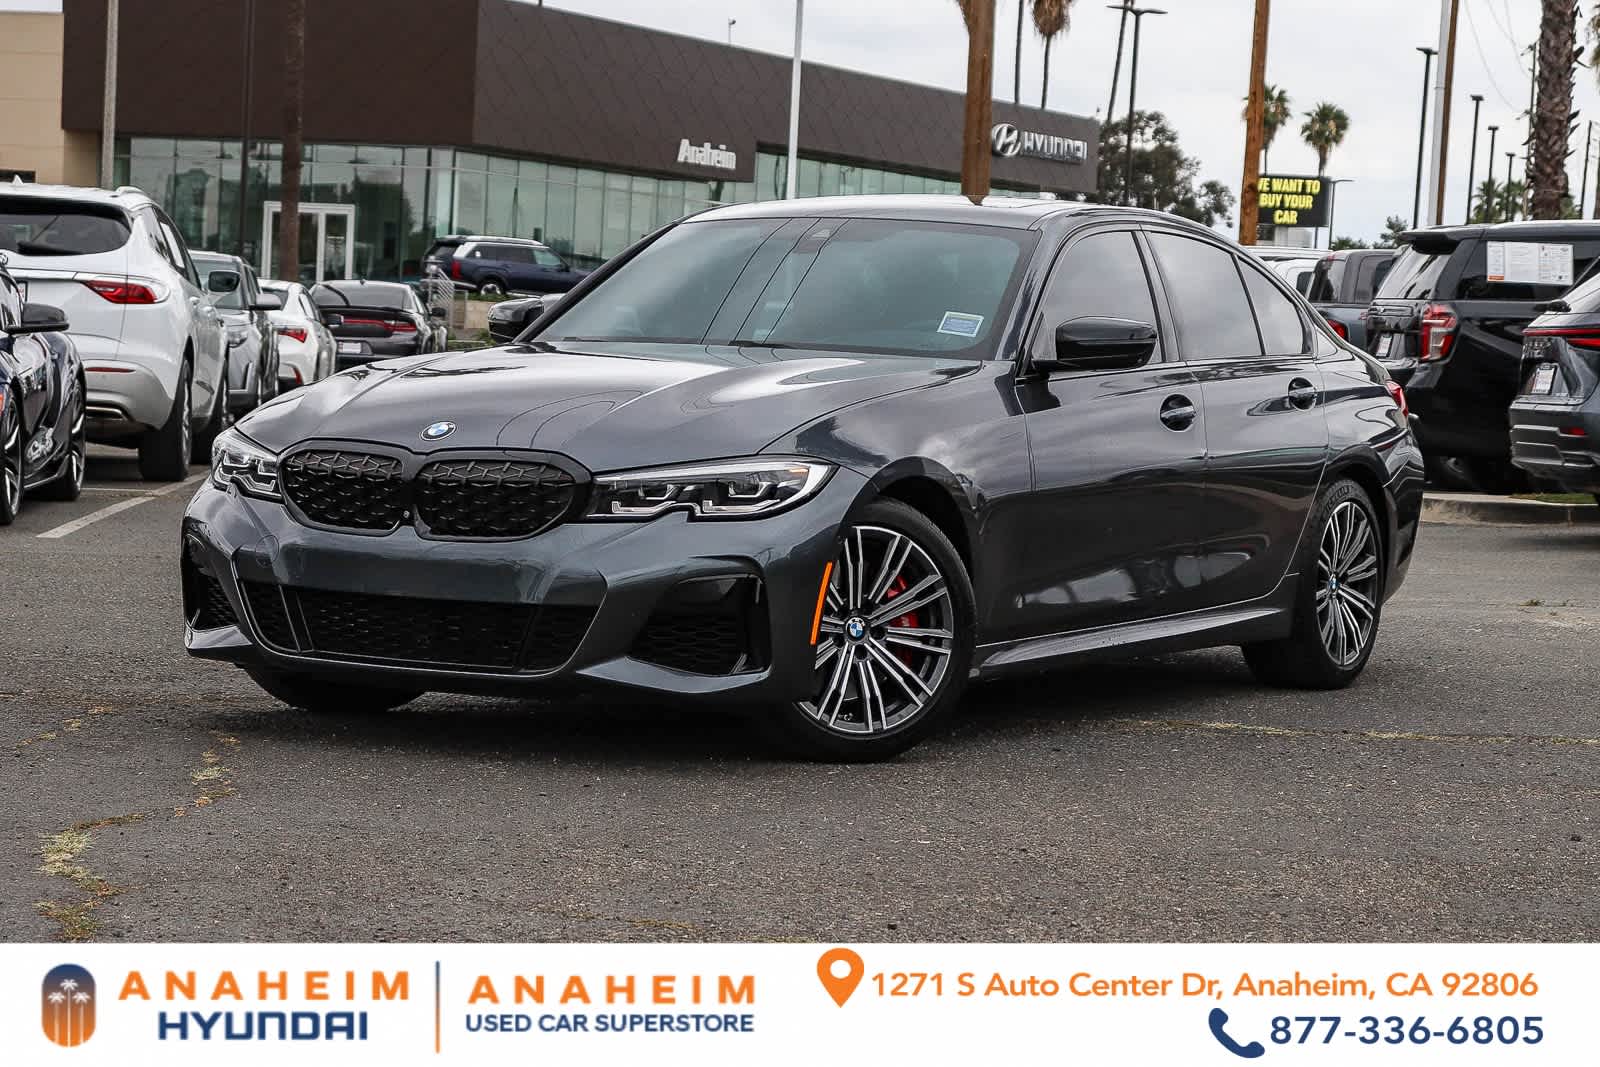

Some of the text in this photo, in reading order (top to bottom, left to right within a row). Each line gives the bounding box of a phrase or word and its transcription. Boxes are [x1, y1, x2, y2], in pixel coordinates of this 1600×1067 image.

[677, 139, 736, 169] Anaheim
[1023, 130, 1088, 161] HYUNDAI
[1271, 178, 1304, 193] WANT
[1305, 180, 1320, 195] TO
[1259, 193, 1313, 210] BUY YOUR
[1273, 210, 1298, 225] CAR
